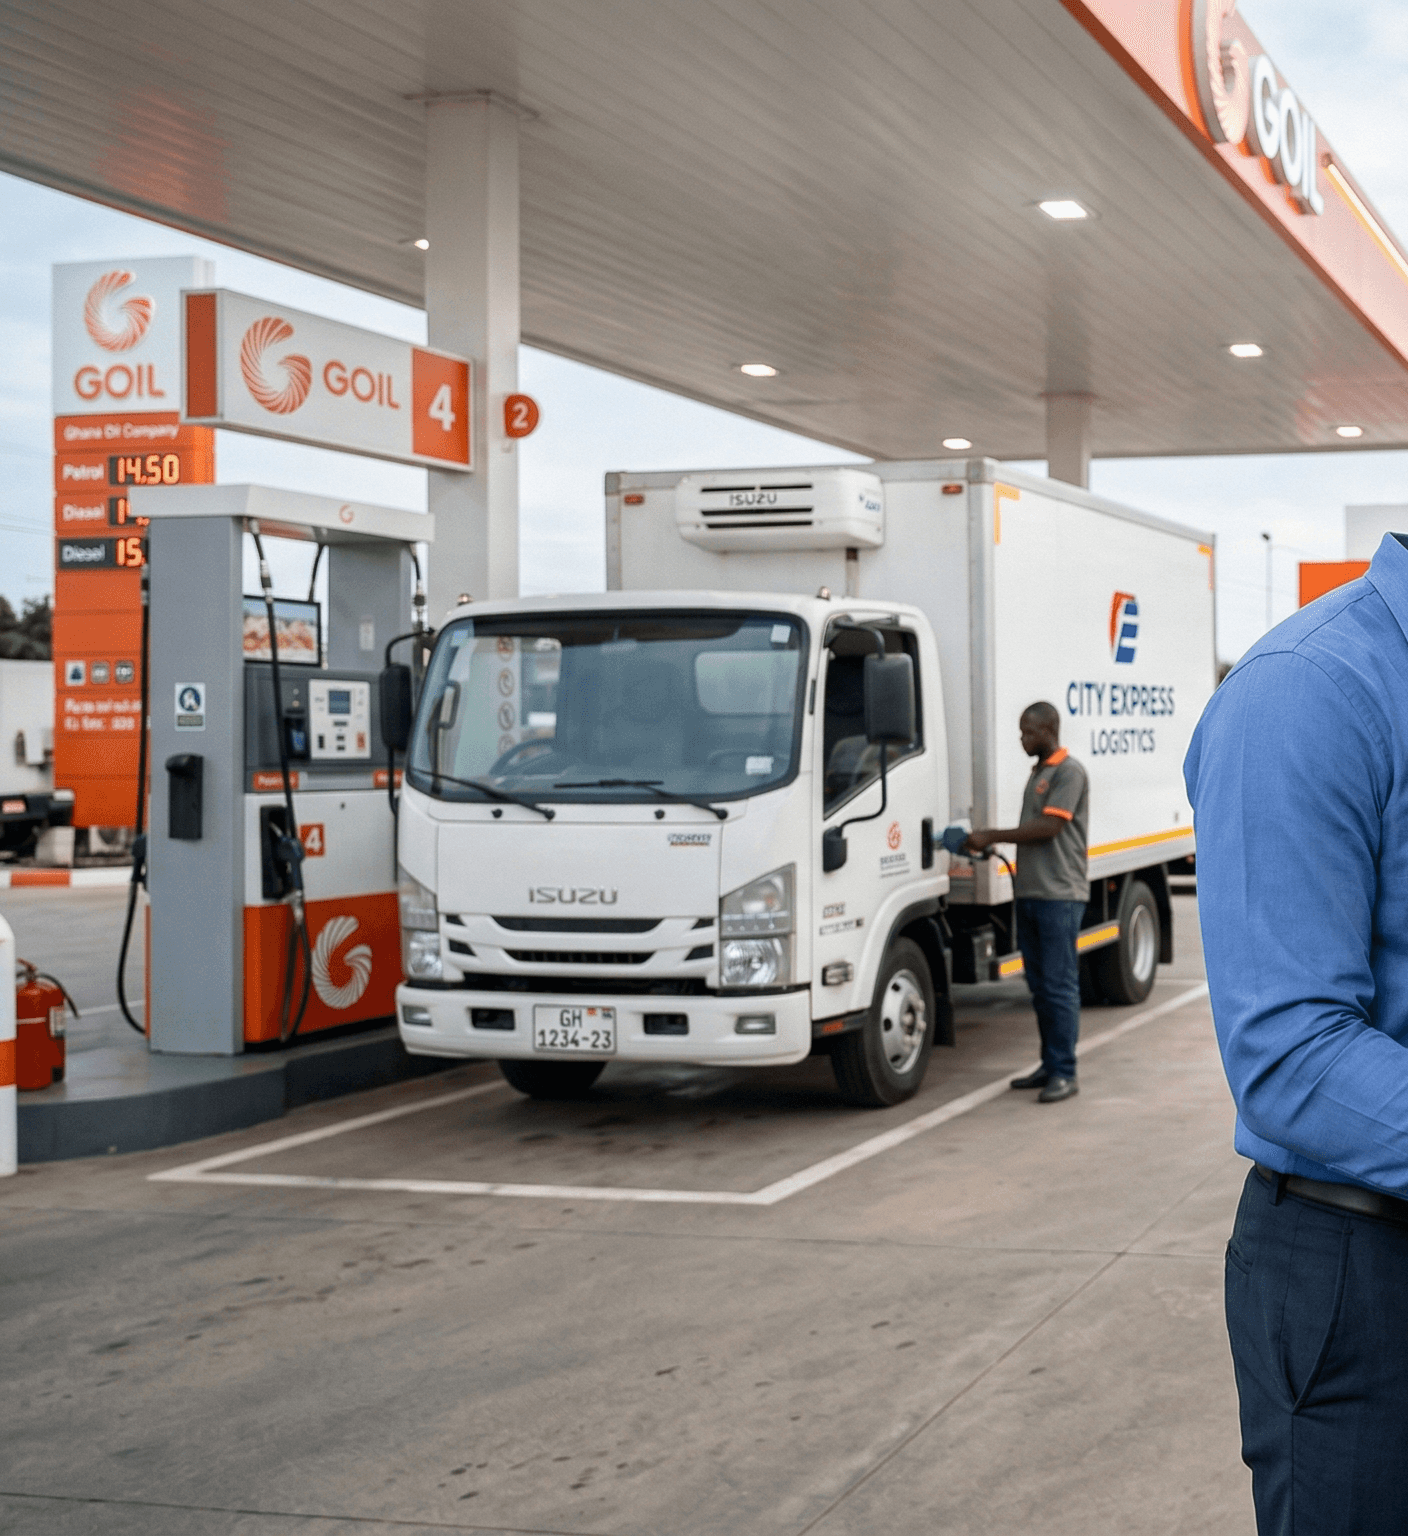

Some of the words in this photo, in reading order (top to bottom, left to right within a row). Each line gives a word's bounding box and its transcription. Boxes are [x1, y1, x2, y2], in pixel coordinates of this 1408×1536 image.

[1253, 53, 1325, 216] GOIL
[74, 364, 166, 400] GOIL
[323, 360, 400, 410] GOIL
[428, 384, 455, 431] 4
[513, 402, 528, 429] 2
[117, 454, 180, 485] 14.50
[729, 493, 777, 506] ISUZU
[1066, 681, 1106, 716] CITY
[1110, 683, 1175, 717] EXPRESS
[1091, 728, 1155, 756] LOGISTICS
[305, 826, 322, 852] 4
[529, 886, 618, 905] ISUZU
[559, 1008, 583, 1028] GH
[537, 1029, 613, 1049] 1234-23
